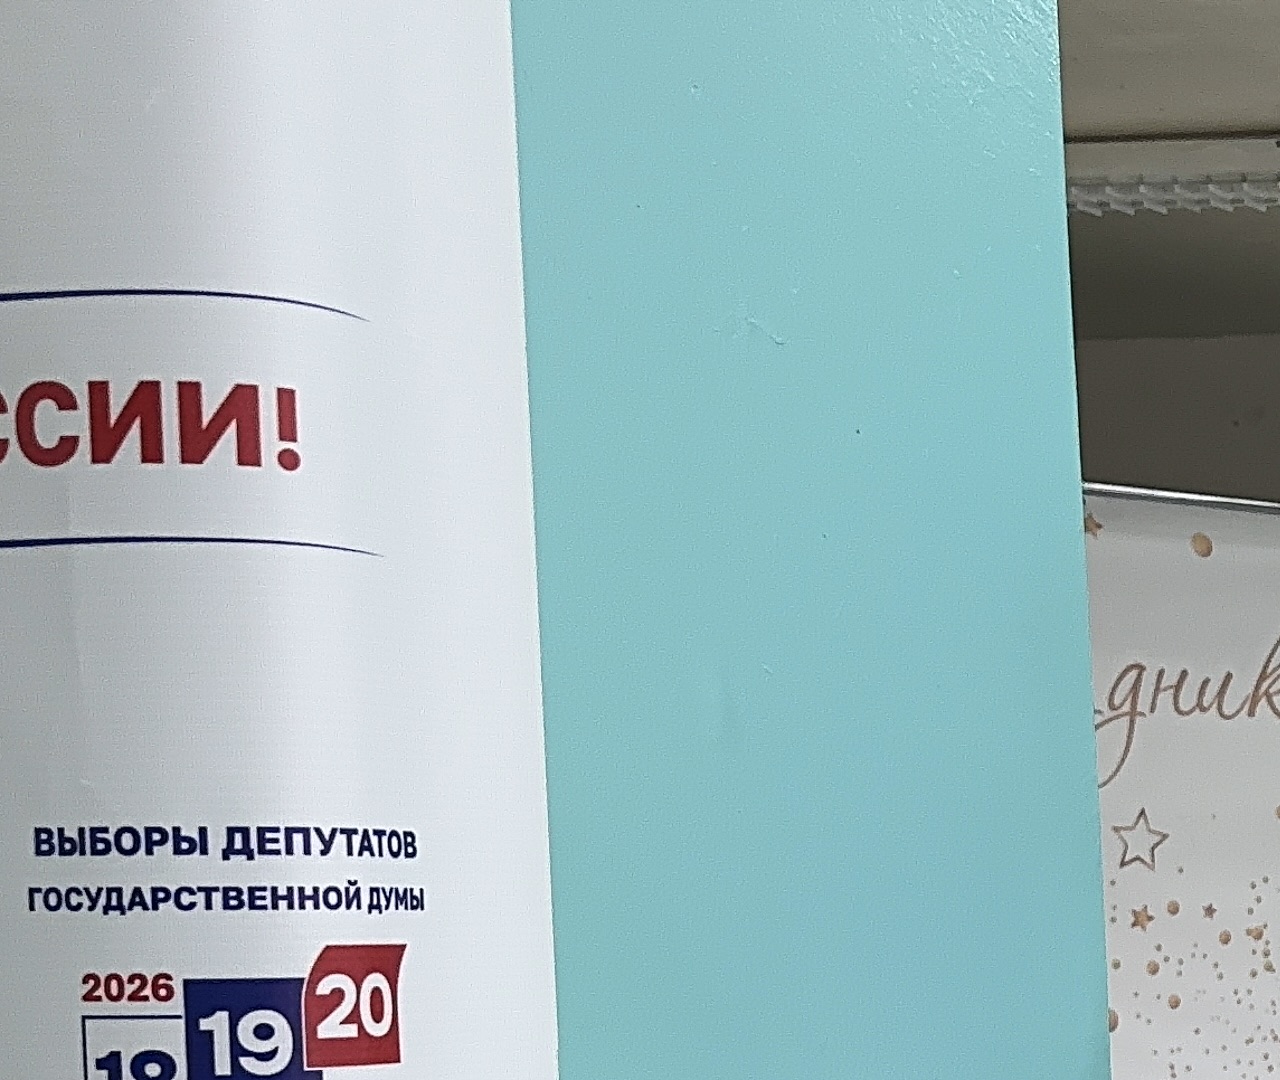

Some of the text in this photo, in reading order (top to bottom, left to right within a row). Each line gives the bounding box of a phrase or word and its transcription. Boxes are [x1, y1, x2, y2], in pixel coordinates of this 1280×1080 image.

[0, 381, 299, 470] СИИ!
[34, 826, 417, 861] ВЫБОРЫ ДЕПУТАТОВ
[28, 880, 424, 915] ГОСУДАРСТВЕННОЙ ДУМЫ
[82, 973, 174, 1002] 2026
[199, 1010, 293, 1075] 19
[316, 973, 392, 1039] 20
